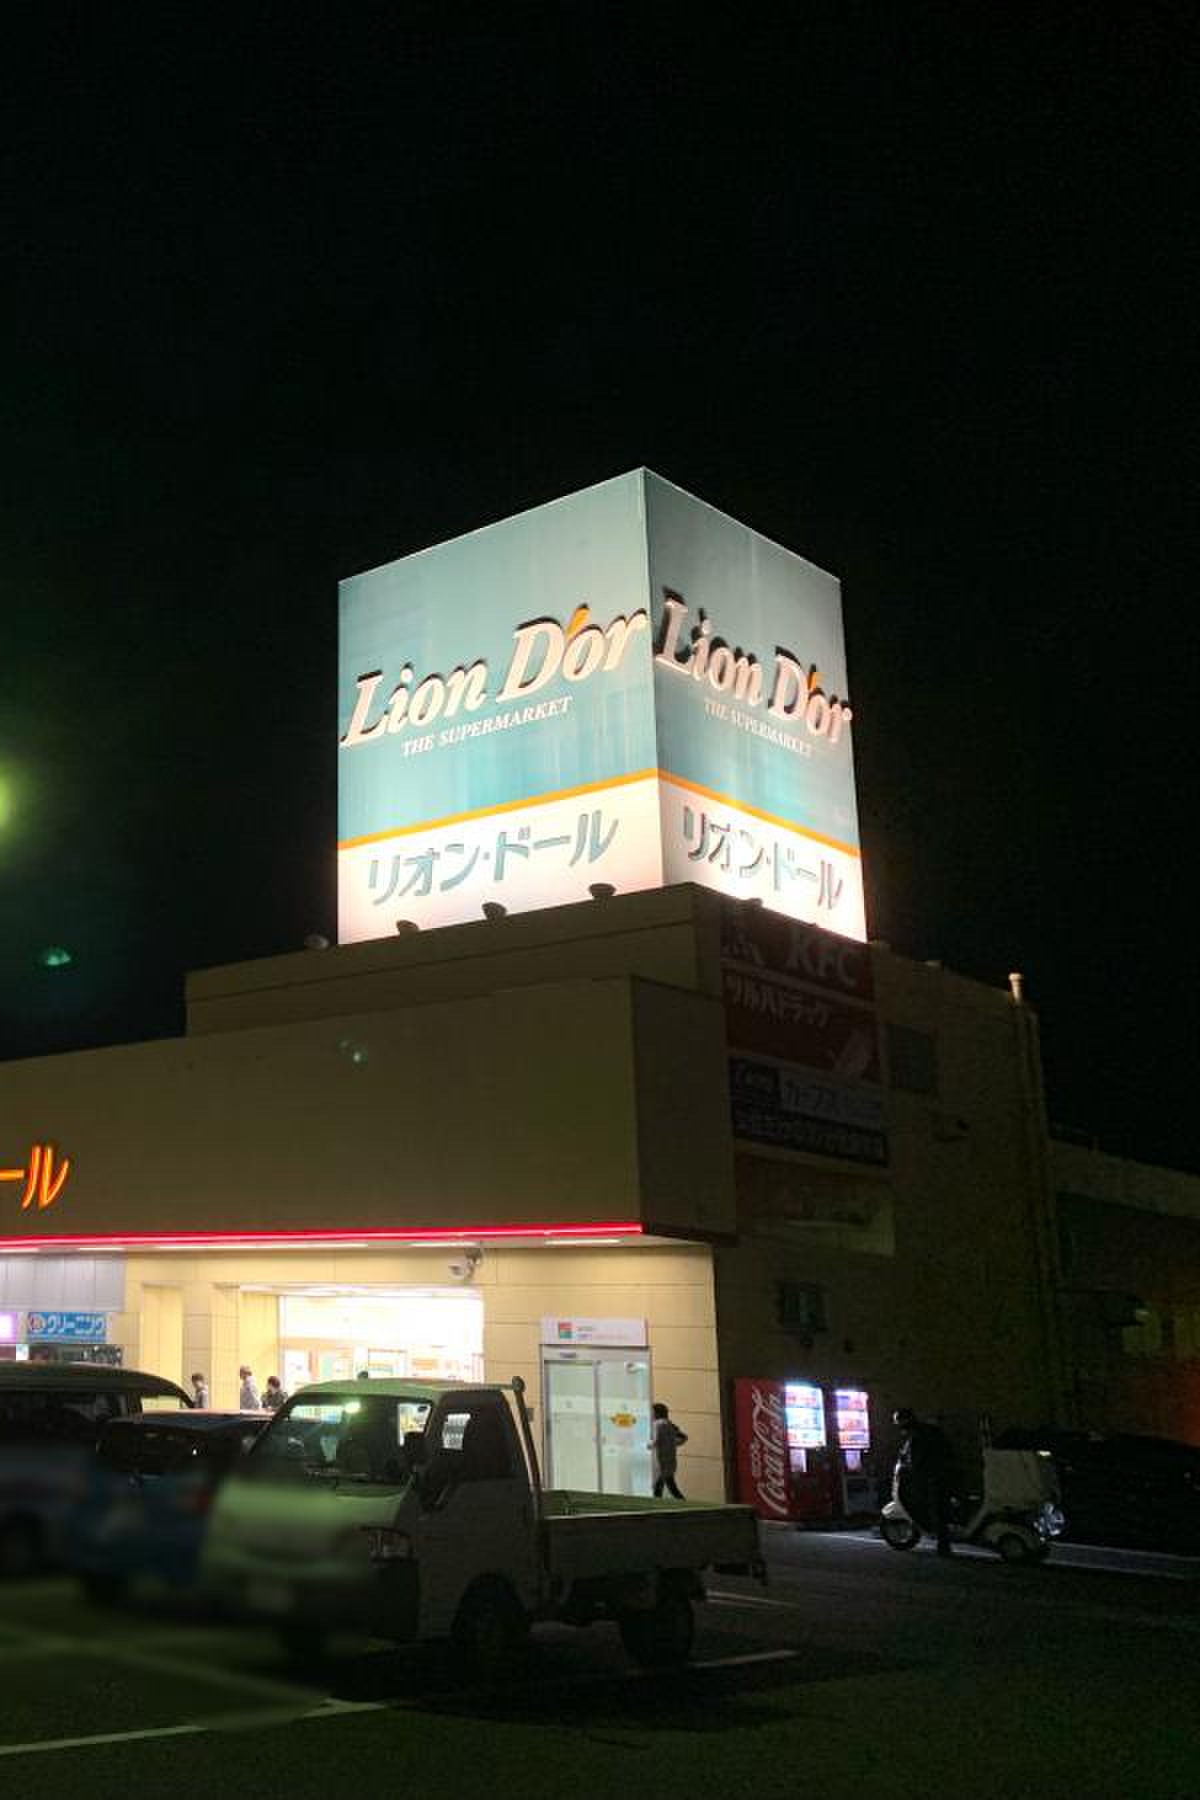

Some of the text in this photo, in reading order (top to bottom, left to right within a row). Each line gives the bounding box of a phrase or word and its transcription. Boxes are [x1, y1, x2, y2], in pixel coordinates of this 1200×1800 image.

[655, 592, 763, 706] Lion
[340, 662, 487, 746] Lion
[402, 695, 573, 757] THE SUPERMARKET
